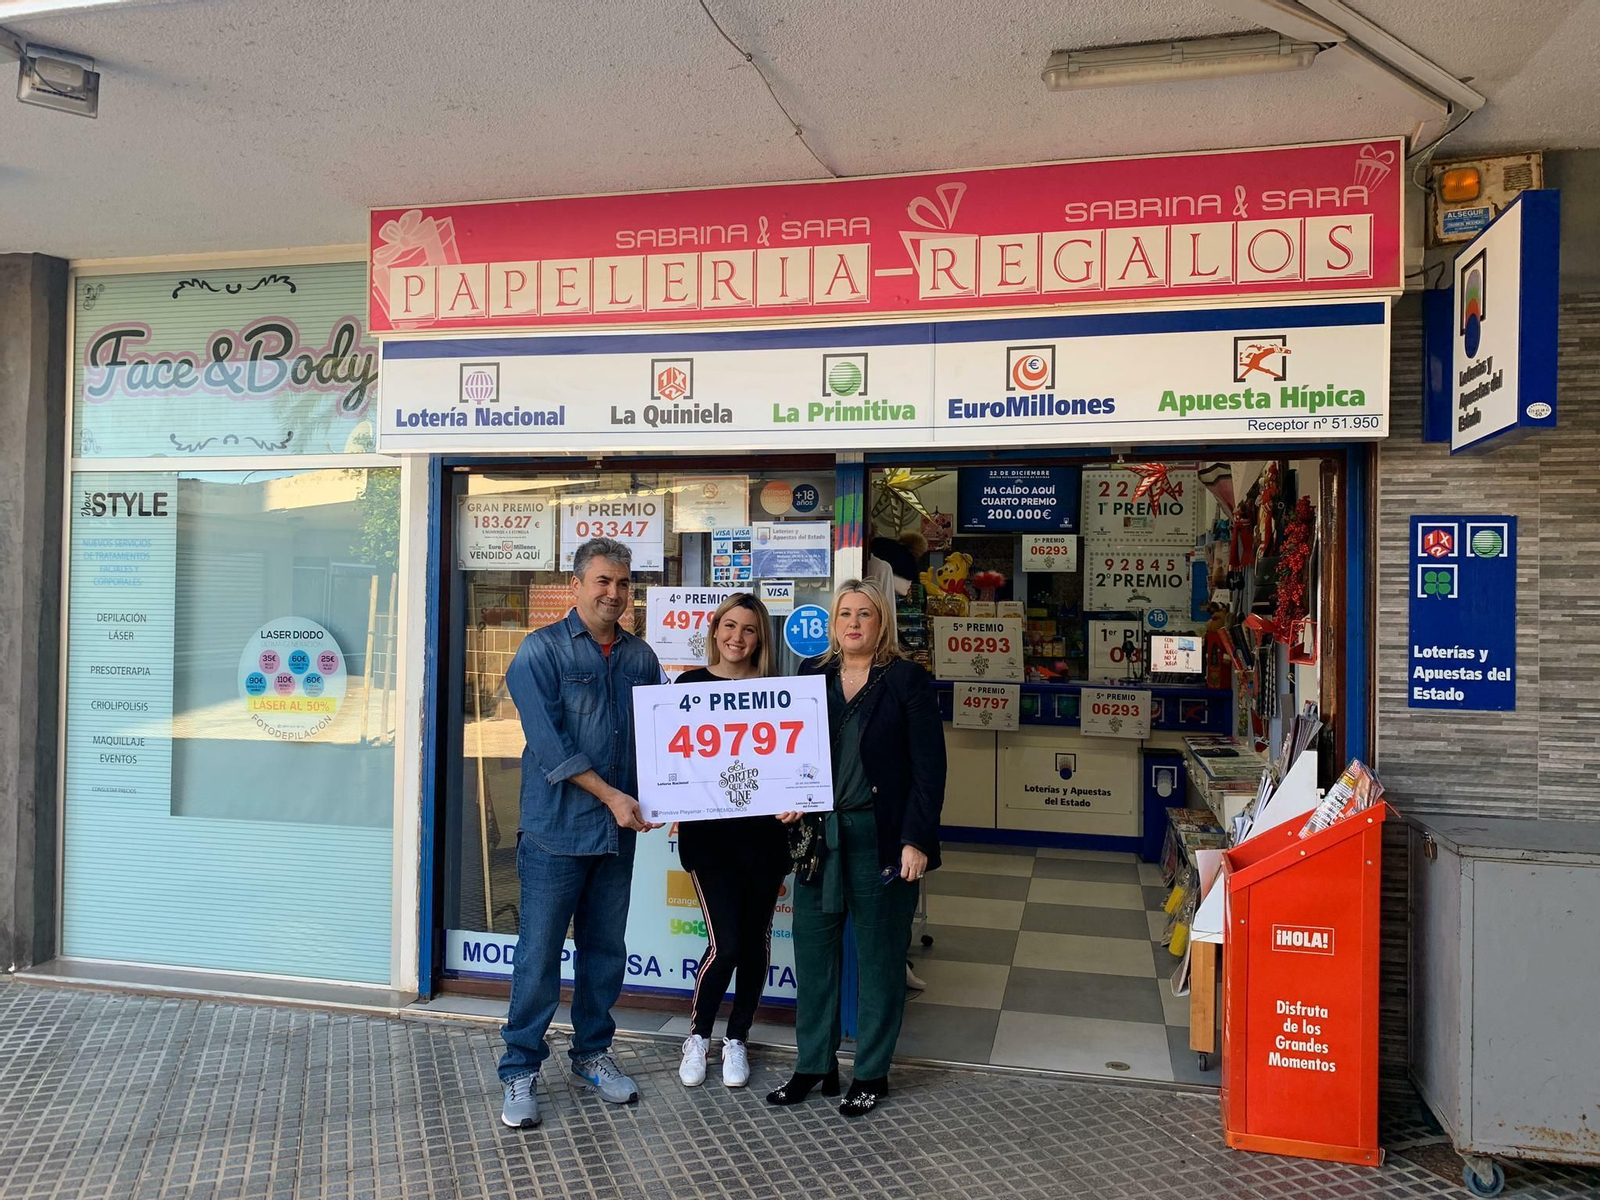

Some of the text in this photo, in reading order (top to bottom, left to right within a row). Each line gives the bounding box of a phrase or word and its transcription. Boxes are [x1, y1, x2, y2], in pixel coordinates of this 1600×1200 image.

[1064, 185, 1369, 222] SABRINA & SARA
[1447, 209, 1484, 218] ALSEGUR
[615, 216, 871, 249] SABRINA & SARA
[403, 224, 1357, 314] PAPELERIA REGALOS
[87, 329, 198, 397] Face
[242, 323, 379, 411] Body
[948, 393, 1116, 419] EuroMillones
[1158, 383, 1366, 417] Apuesta Hípica
[396, 405, 566, 428] Lotería Nacional
[611, 402, 733, 428] La Quiniela
[773, 399, 916, 423] La Primitiva
[1247, 416, 1379, 433] Receptor nº 51.950
[1458, 407, 1482, 432] Estado
[795, 490, 815, 500] +18
[984, 484, 1056, 495] HA CAÍDO AQUÍ
[92, 492, 168, 517] STYLE
[467, 502, 544, 513] GRAN PREMIO
[981, 497, 1057, 506] CUARTO PREMIO
[588, 502, 656, 517] PREMIO
[987, 509, 1052, 520] 200.000€
[1113, 502, 1184, 516] PREMIO
[473, 515, 532, 529] 183.627
[575, 520, 649, 538] 03347
[469, 549, 541, 560] VENDIDO AQUÍ
[1031, 546, 1068, 555] 06293
[1113, 573, 1183, 588] PREMIO
[766, 588, 789, 597] VISA
[96, 612, 147, 623] DEPILACIÓN
[1150, 613, 1164, 622] +18
[791, 618, 824, 639] +18
[953, 623, 1004, 632] 5º PREMIO
[108, 629, 134, 641] LÁSER
[261, 630, 324, 640] LASER DIODO
[1101, 628, 1117, 642] 1er
[947, 636, 1011, 654] 06293
[262, 654, 335, 663] 35€ 60€ 25€
[1413, 645, 1489, 663] Loterías y
[90, 665, 151, 676] PRESOTERAPIA
[1413, 666, 1511, 682] Apuestas del
[249, 676, 321, 684] 90€ 110€ 60€
[977, 686, 1006, 695] PREMIO
[1106, 693, 1136, 701] PREMIO
[1413, 686, 1465, 701] Estado
[90, 700, 149, 711] CRIOLIPOLISIS
[253, 698, 330, 712] LÁSER AL 50%
[679, 690, 791, 713] 4º PREMIO
[963, 696, 1009, 710] 49797
[1091, 703, 1140, 717] 06293
[251, 713, 332, 740] FOTODEPILACIÓN
[92, 735, 146, 747] MAQUILLAJE
[668, 721, 804, 759] 49797
[99, 753, 138, 765] EVENTOS
[719, 768, 759, 788] SORTEO
[729, 783, 743, 791] QUE
[1062, 788, 1068, 796] y
[1070, 787, 1112, 796] Apuestas
[1044, 797, 1091, 807] del Estado
[668, 897, 698, 907] orange
[1276, 929, 1329, 949] ¡HOLA!
[1276, 1000, 1328, 1019] Disfruta
[1283, 1018, 1321, 1035] de los
[1275, 1035, 1329, 1054] Grandes
[1268, 1052, 1336, 1073] Momentos
